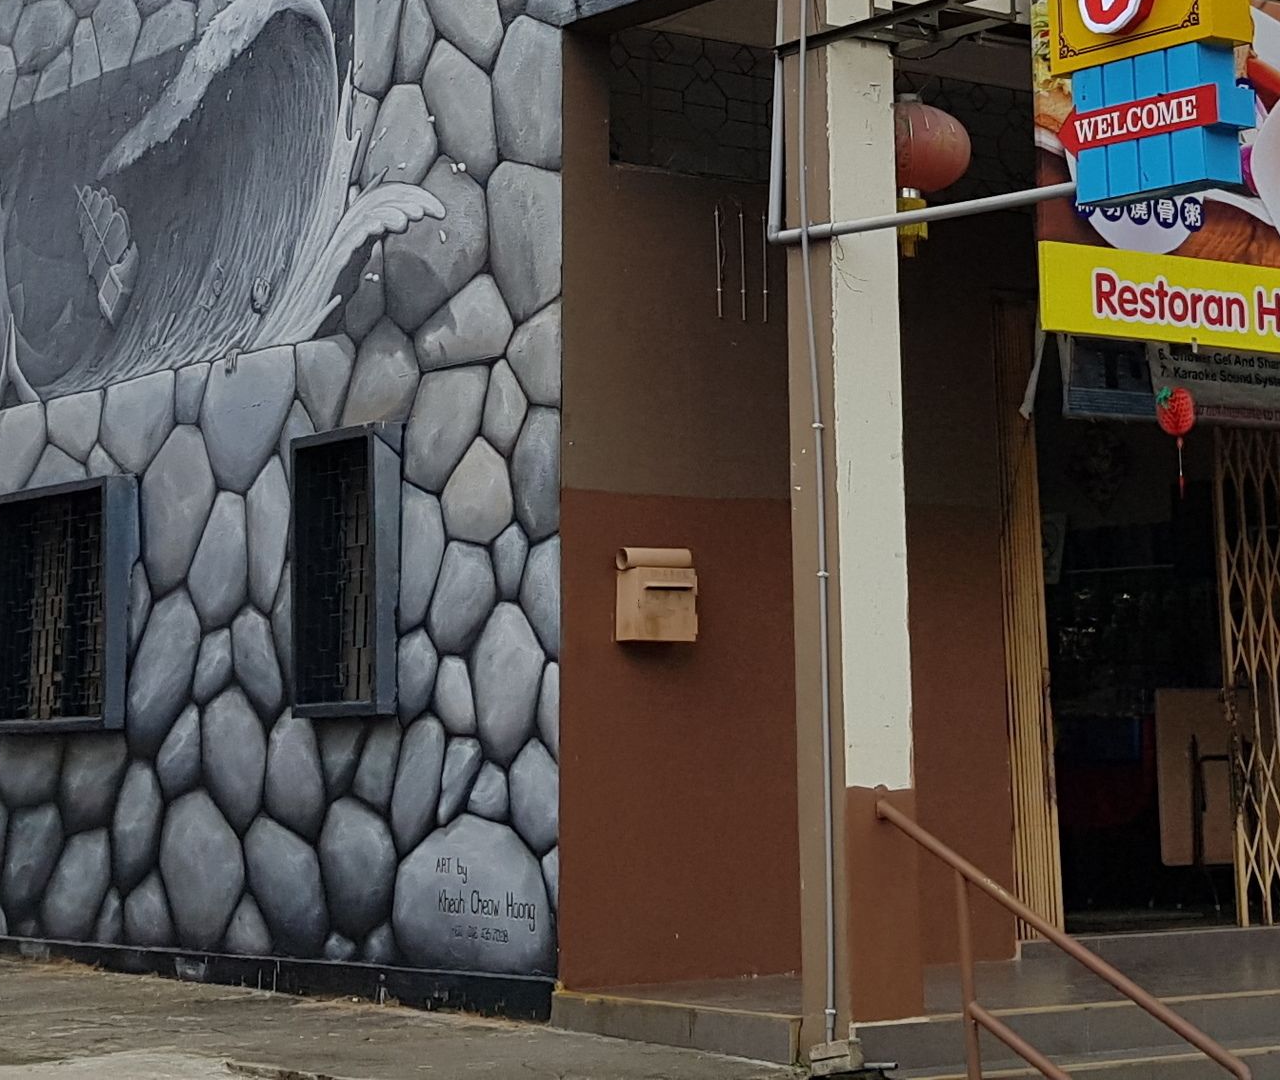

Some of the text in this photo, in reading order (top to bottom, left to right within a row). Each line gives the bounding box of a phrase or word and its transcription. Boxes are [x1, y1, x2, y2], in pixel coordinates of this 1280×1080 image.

[1074, 95, 1197, 144] WELCOME
[1094, 271, 1246, 330] Restoran
[1234, 355, 1255, 368] And
[456, 857, 468, 885] by
